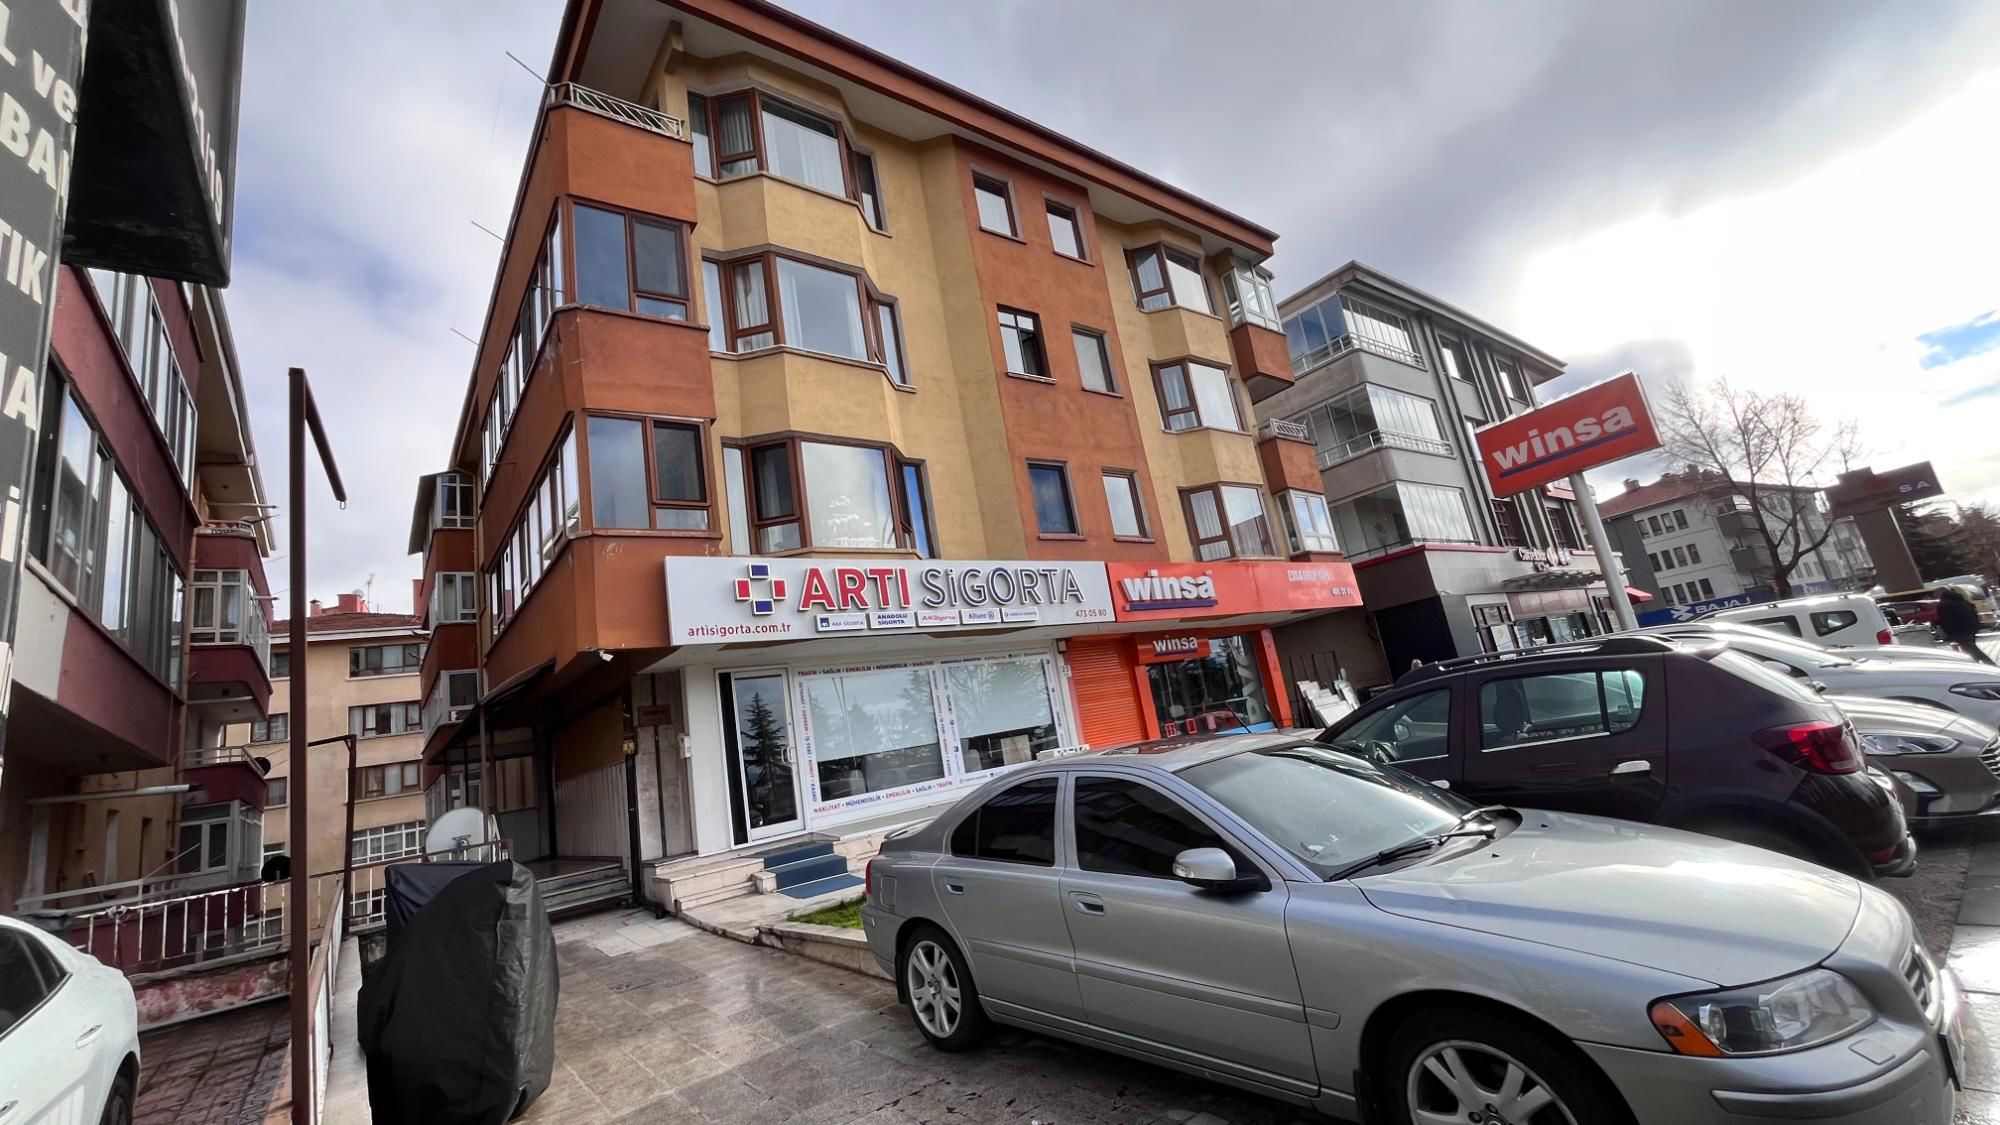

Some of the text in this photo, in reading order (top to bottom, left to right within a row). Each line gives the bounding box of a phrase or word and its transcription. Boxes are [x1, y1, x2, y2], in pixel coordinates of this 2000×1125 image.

[33, 49, 77, 124] ve
[1492, 405, 1636, 470] winsa
[798, 567, 912, 611] ARTI
[1121, 569, 1216, 601] winsa
[1075, 610, 1088, 618] 473
[1098, 609, 1107, 617] 80
[1695, 596, 1751, 615] BAJAJ
[688, 622, 792, 637] artisigorta.com.tr
[1153, 634, 1198, 652] winsa
